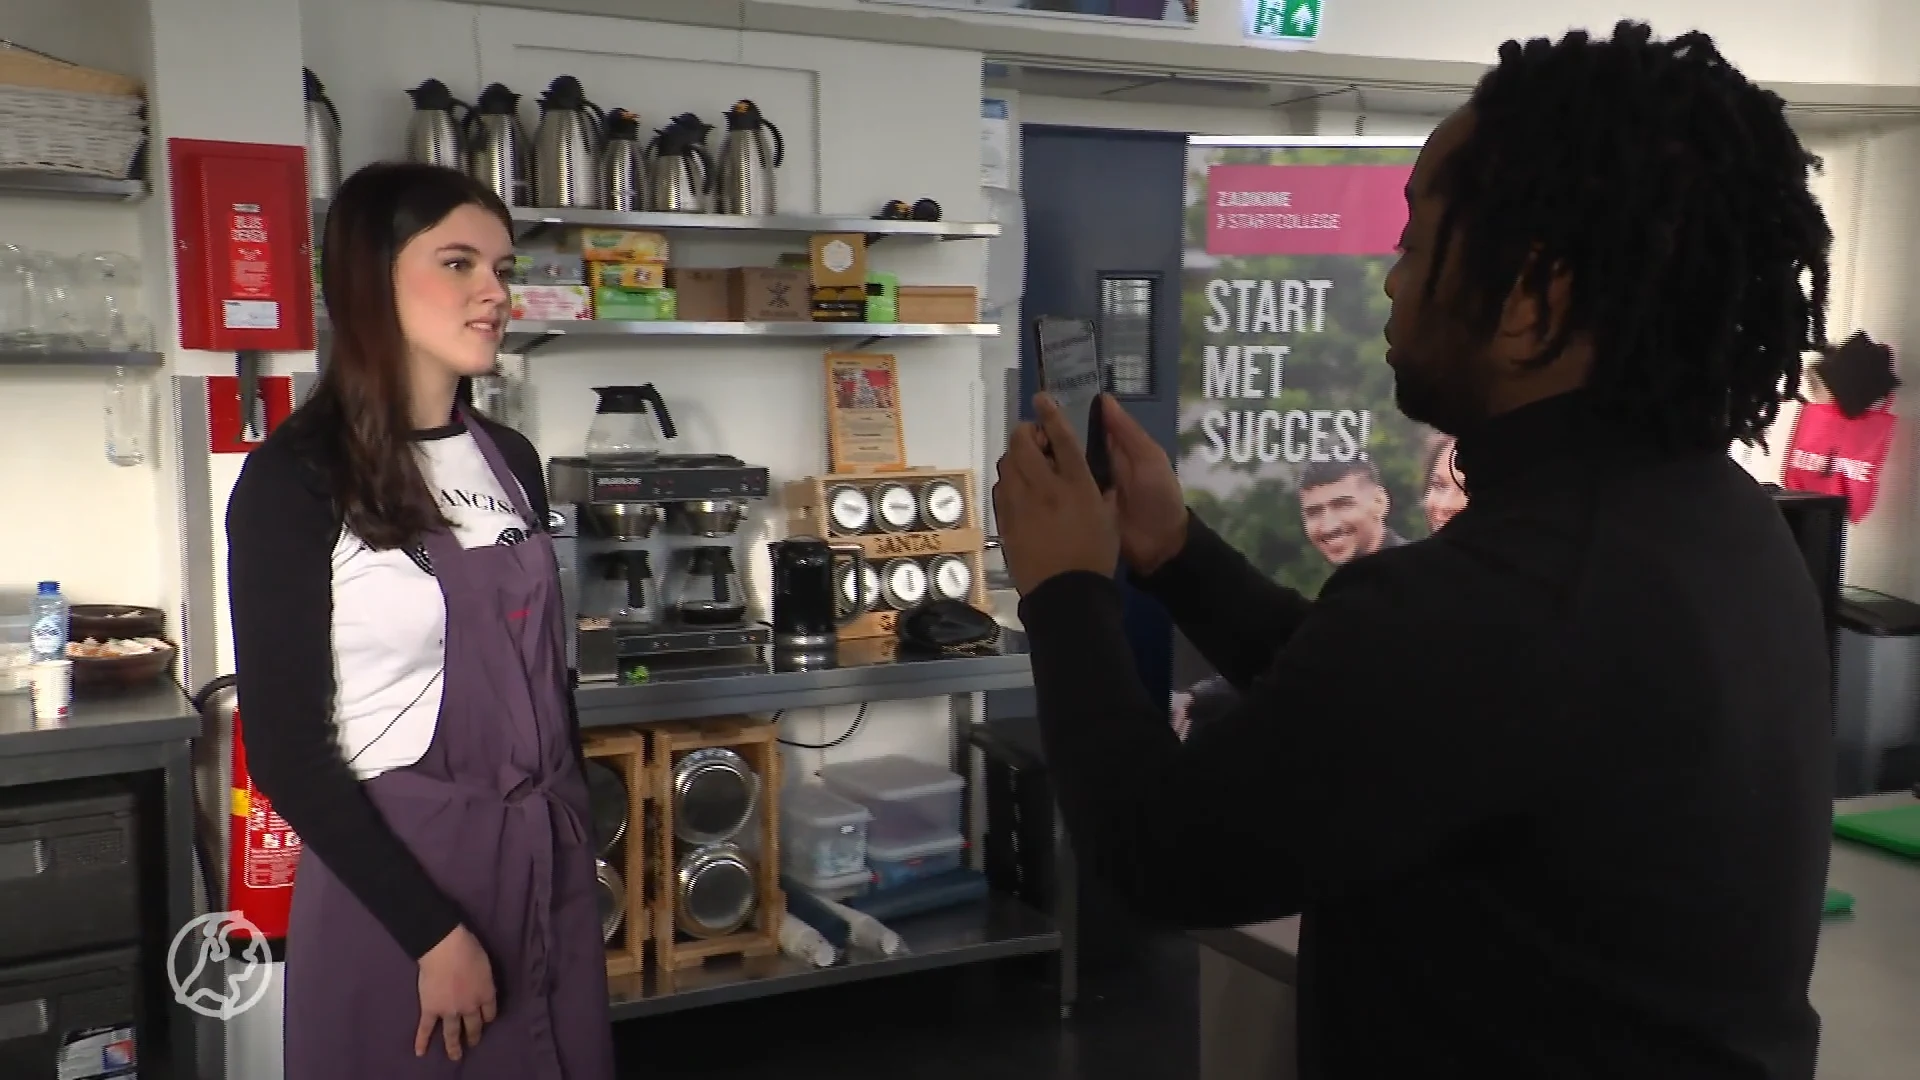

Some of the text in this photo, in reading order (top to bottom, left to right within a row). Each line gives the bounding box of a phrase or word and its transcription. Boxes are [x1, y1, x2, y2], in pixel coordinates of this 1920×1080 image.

[1217, 191, 1292, 207] ZADKINE
[234, 215, 262, 229] BLUS
[1227, 213, 1341, 230] STARTCOLLEGE
[231, 229, 267, 243] DEKEN
[1203, 279, 1334, 333] START
[1203, 345, 1291, 399] MET
[1201, 409, 1371, 463] SUCCES!
[874, 533, 941, 554] SANTAS
